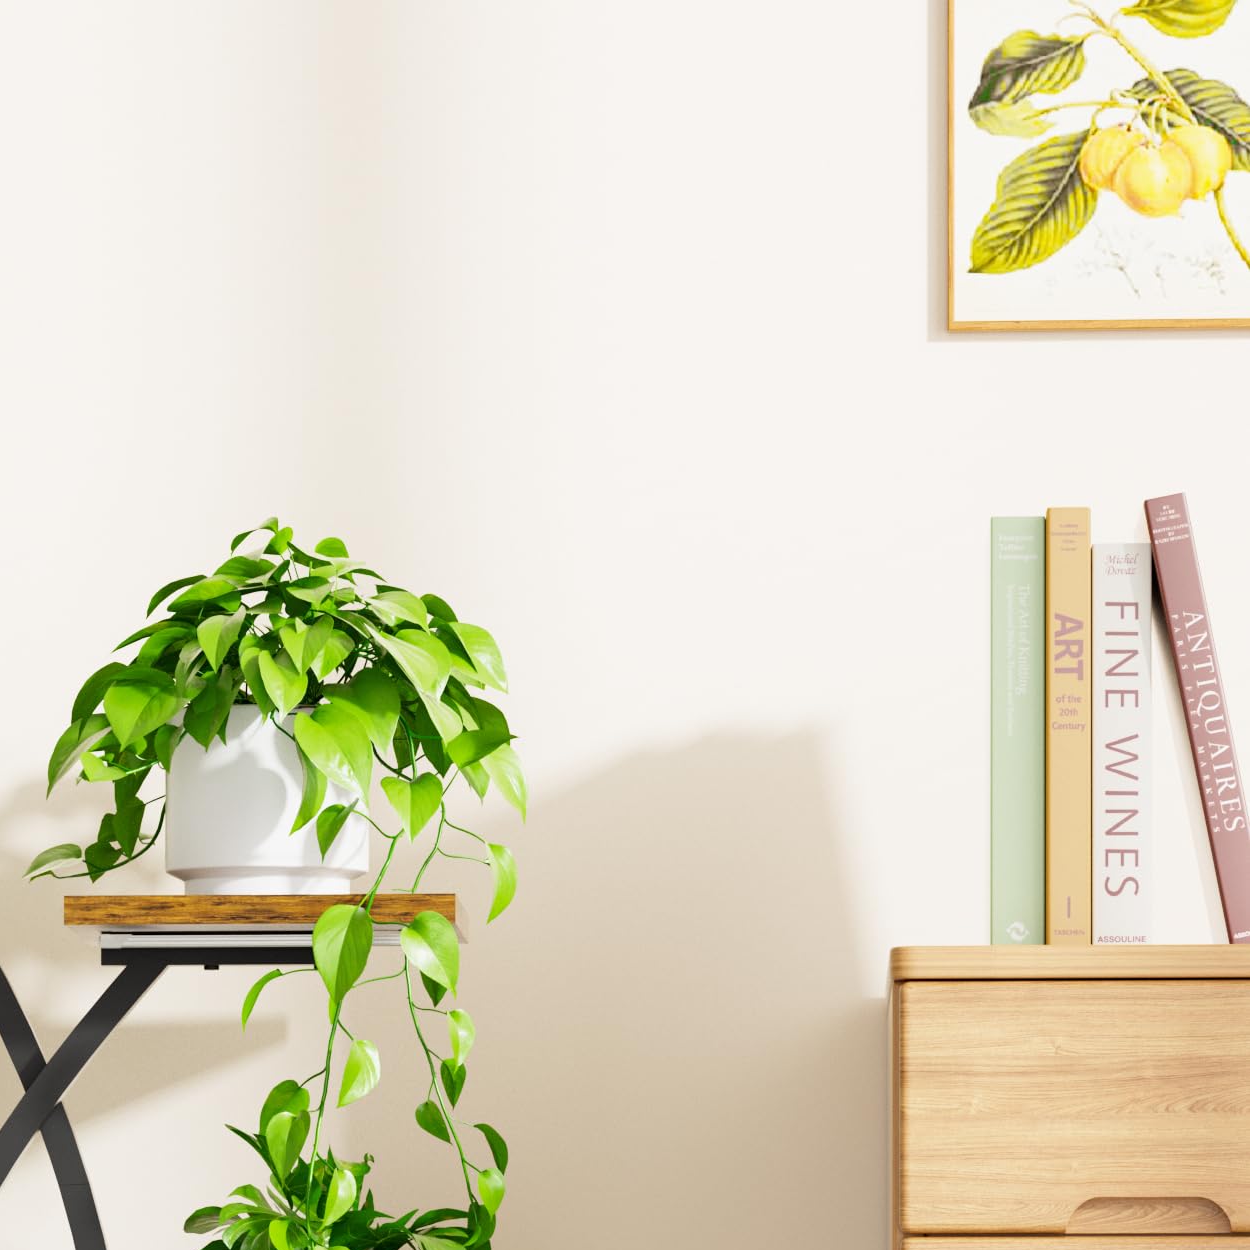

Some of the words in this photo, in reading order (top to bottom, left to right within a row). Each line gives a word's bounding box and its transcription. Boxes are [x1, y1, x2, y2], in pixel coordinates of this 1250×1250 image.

[1054, 613, 1084, 681] ART
[1104, 602, 1139, 708] FINE
[1052, 721, 1086, 732] Century
[1055, 694, 1067, 704] of
[1067, 694, 1082, 704] the
[1058, 708, 1079, 717] 20th
[1171, 614, 1189, 671] PARIS
[1185, 686, 1200, 730] FLEA
[1197, 746, 1221, 833] MARKETS
[1183, 610, 1245, 832] ANTIQUAIRES
[1104, 733, 1139, 896] WINES
[1097, 935, 1147, 943] ASSOULINE
